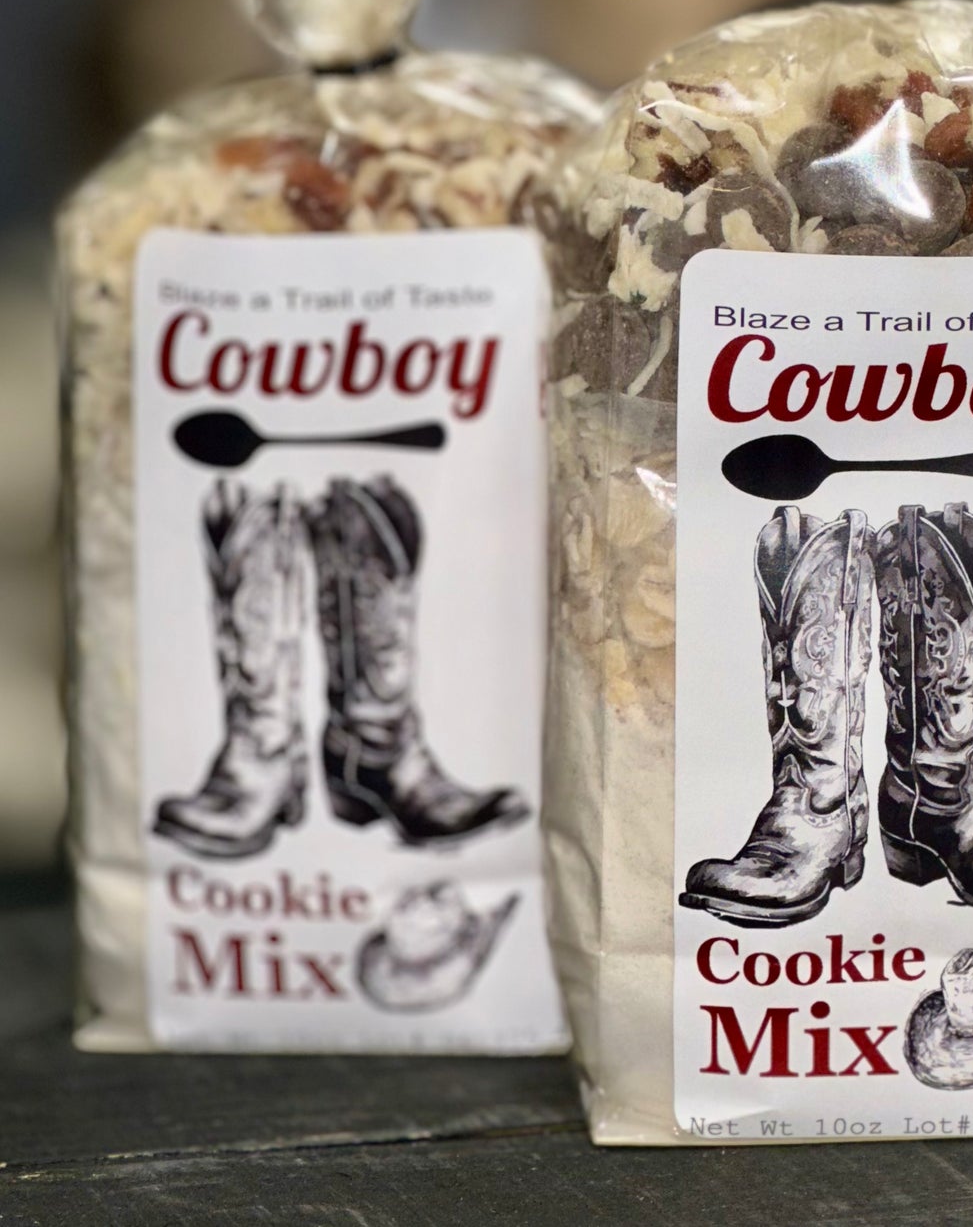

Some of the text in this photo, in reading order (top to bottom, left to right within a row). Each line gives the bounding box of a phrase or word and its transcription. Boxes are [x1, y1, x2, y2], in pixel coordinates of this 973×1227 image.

[250, 290, 271, 311] a
[283, 285, 353, 311] Trail
[361, 284, 395, 311] of
[713, 306, 811, 330] Blaze
[824, 313, 844, 332] a
[857, 310, 932, 333] Trail
[156, 308, 501, 420] Cowboy
[166, 864, 370, 921] Cookie
[170, 926, 348, 1000] Mix
[696, 934, 926, 987] Cookie
[699, 1001, 899, 1078] Mix
[689, 1116, 740, 1136] Net
[760, 1118, 794, 1136] Wt
[816, 1116, 882, 1136] 10oz
[903, 1113, 970, 1135] Lot#
